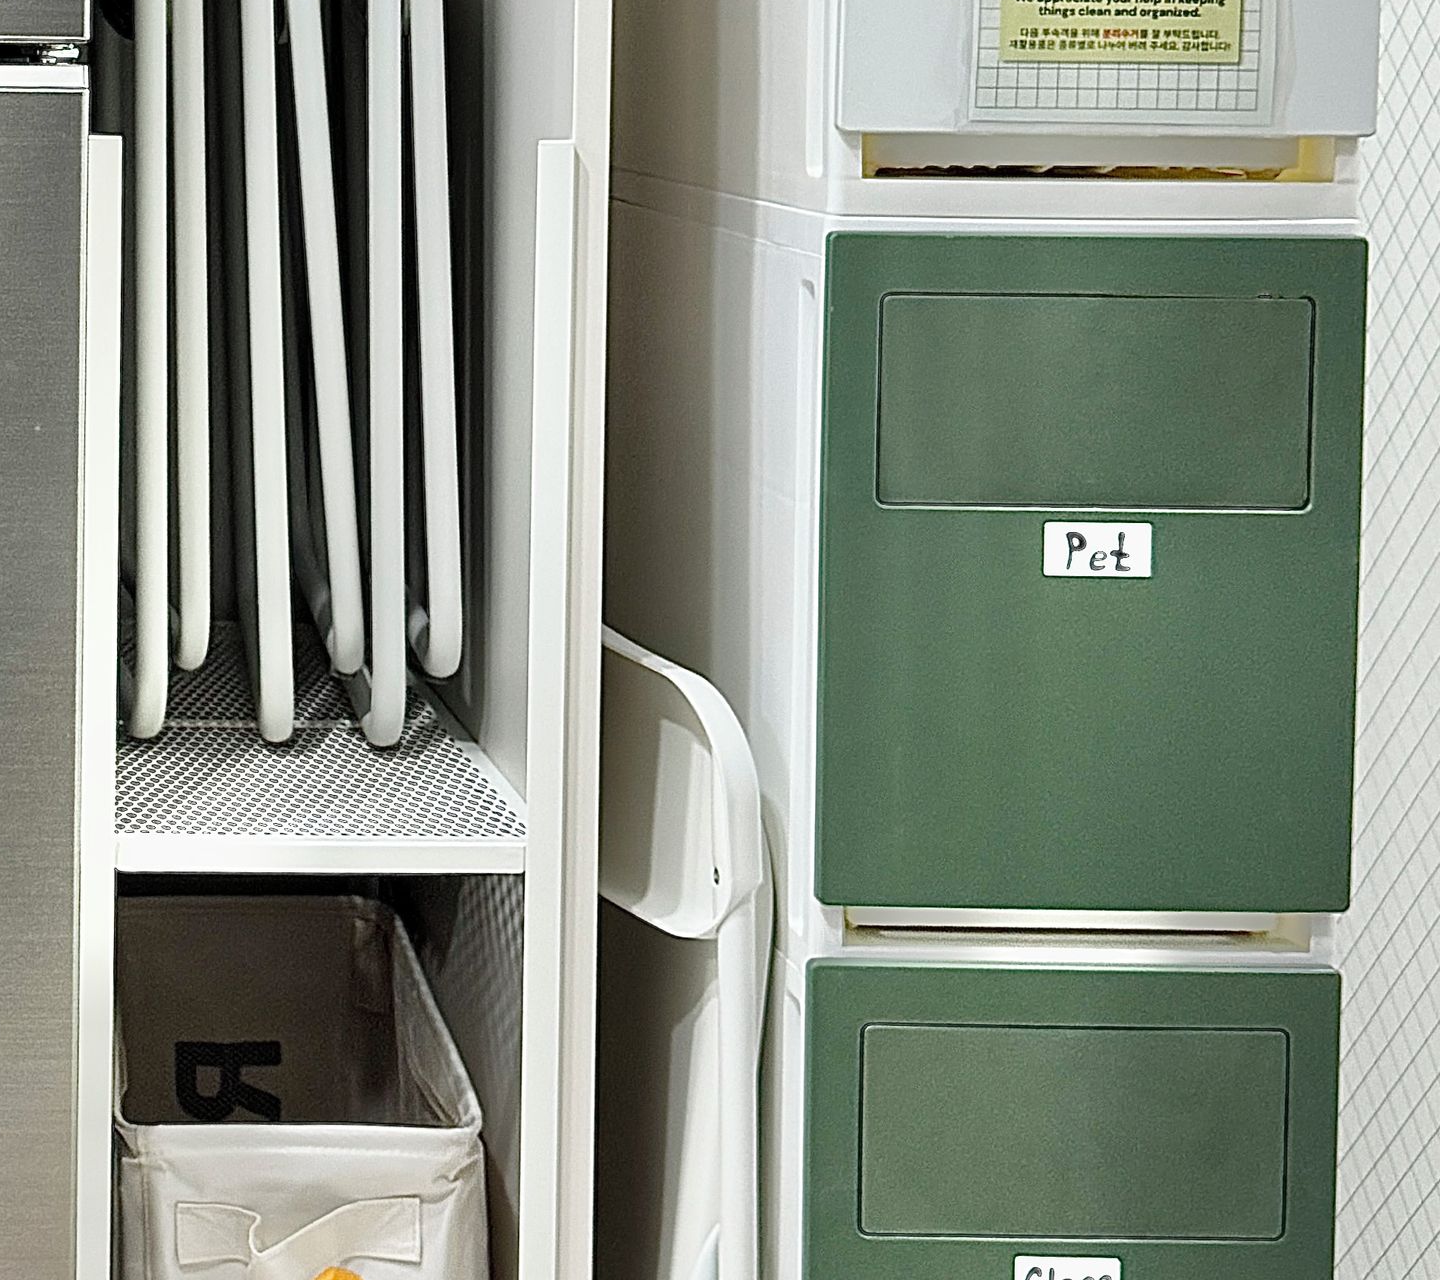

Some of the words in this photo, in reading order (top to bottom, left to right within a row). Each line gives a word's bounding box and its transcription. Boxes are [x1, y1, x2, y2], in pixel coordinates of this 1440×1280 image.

[1039, 6, 1076, 18] things
[1078, 6, 1111, 16] clean
[1114, 6, 1137, 17] and
[1139, 7, 1201, 19] organized.
[1020, 28, 1039, 38] 다음
[1066, 531, 1131, 571] Pet
